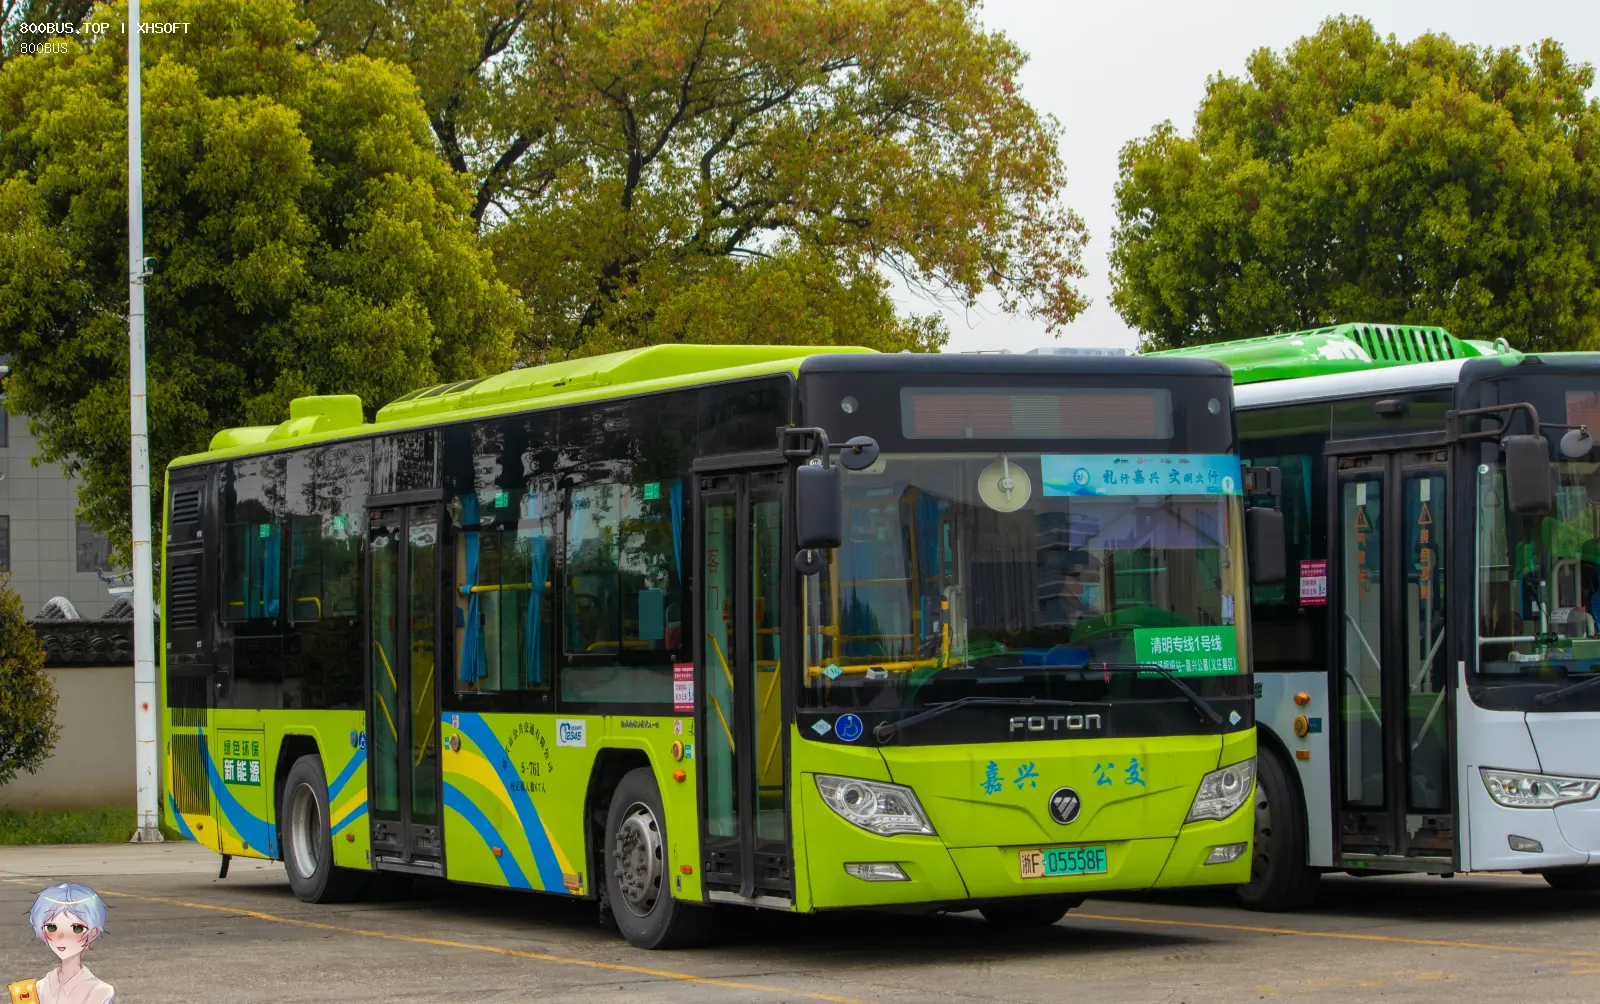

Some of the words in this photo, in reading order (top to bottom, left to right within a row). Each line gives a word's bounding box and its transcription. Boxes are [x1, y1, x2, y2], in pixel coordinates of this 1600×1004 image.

[1102, 468, 1160, 485] 礼行嘉兴
[1168, 468, 1220, 486] 文明出行
[707, 516, 719, 610] 上客门
[1150, 634, 1223, 654] 清明专线1号线
[1009, 713, 1101, 732] FOTON
[565, 731, 582, 741] 12345
[223, 740, 259, 757] 绿色环保
[223, 759, 260, 783] 新能源
[521, 761, 540, 777] 5-761
[980, 760, 1040, 795] 嘉兴
[1092, 757, 1147, 787] 公交
